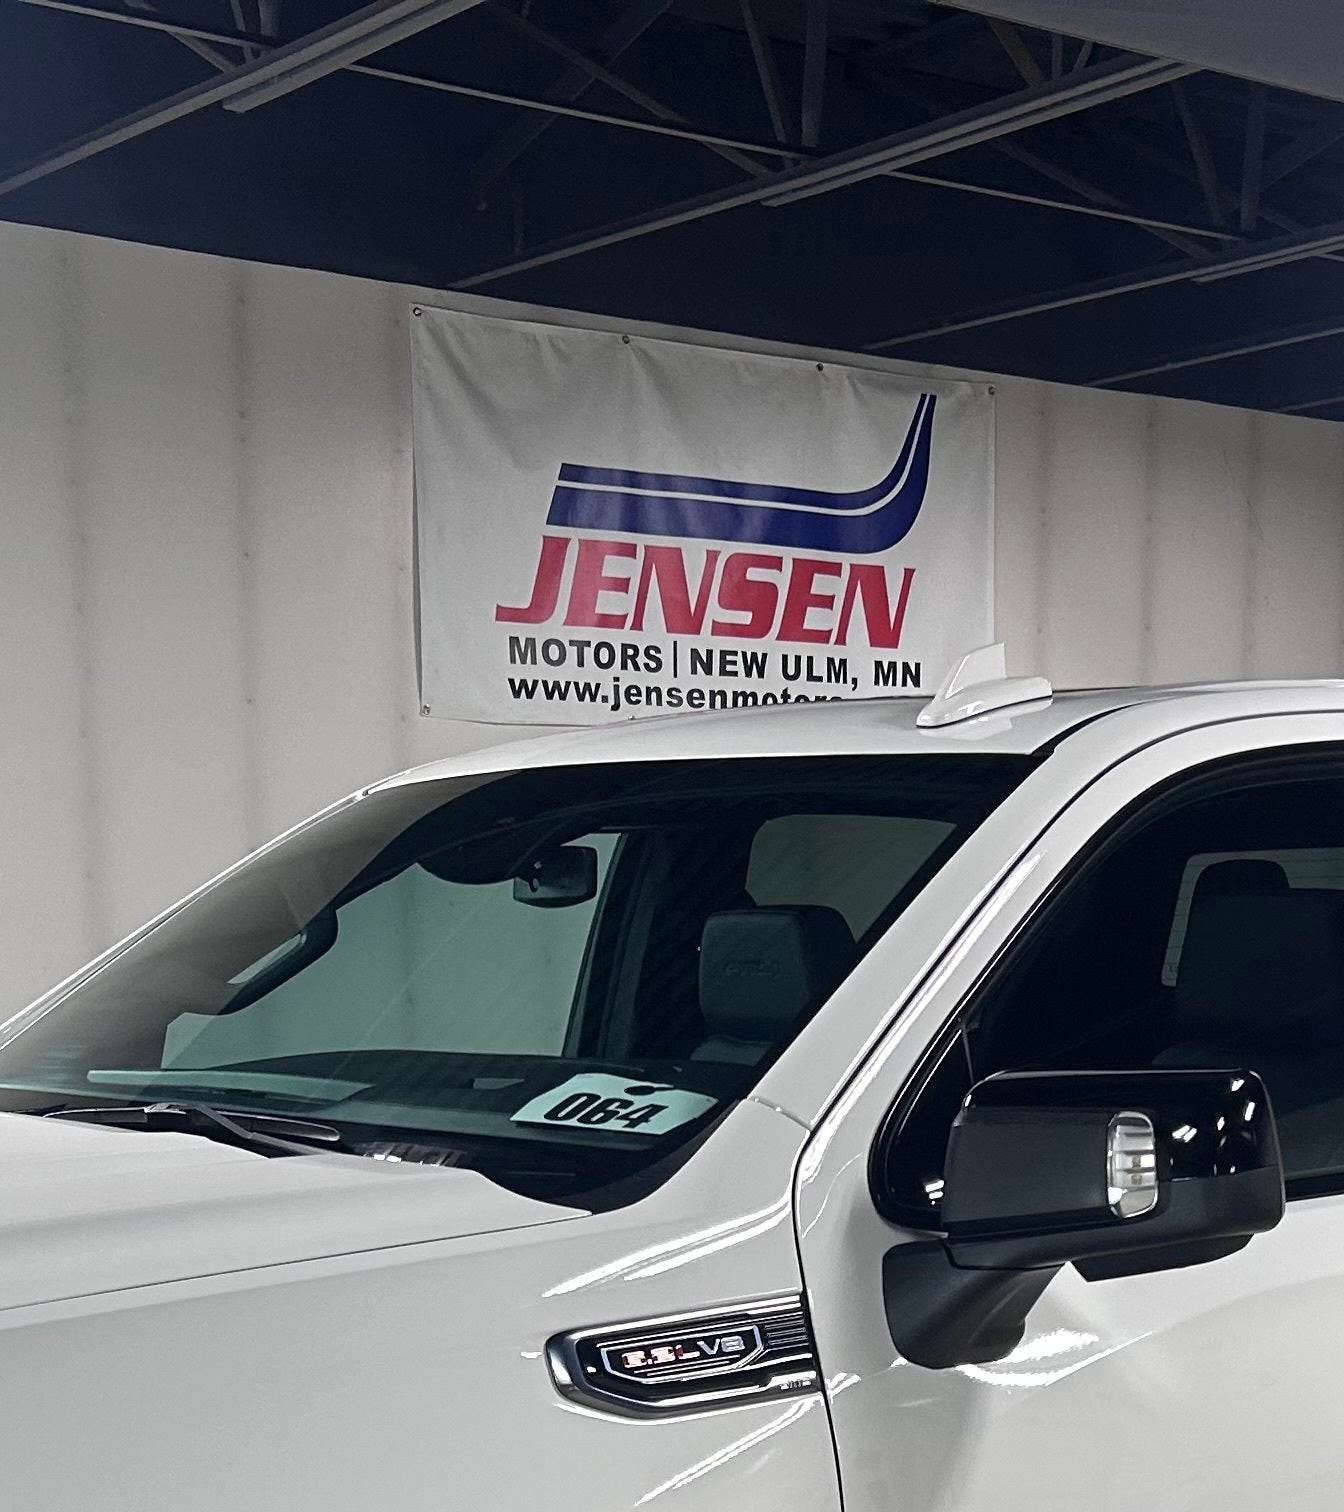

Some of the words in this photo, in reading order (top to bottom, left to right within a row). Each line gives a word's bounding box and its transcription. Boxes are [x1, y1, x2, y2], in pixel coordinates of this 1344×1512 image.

[495, 534, 916, 649] JENSEN
[508, 635, 663, 673] MOTORS
[690, 647, 768, 679] NEW
[782, 654, 857, 690] ULM,
[874, 660, 921, 688] MN
[508, 677, 844, 711] www.jensenmot
[543, 1092, 668, 1129] 064
